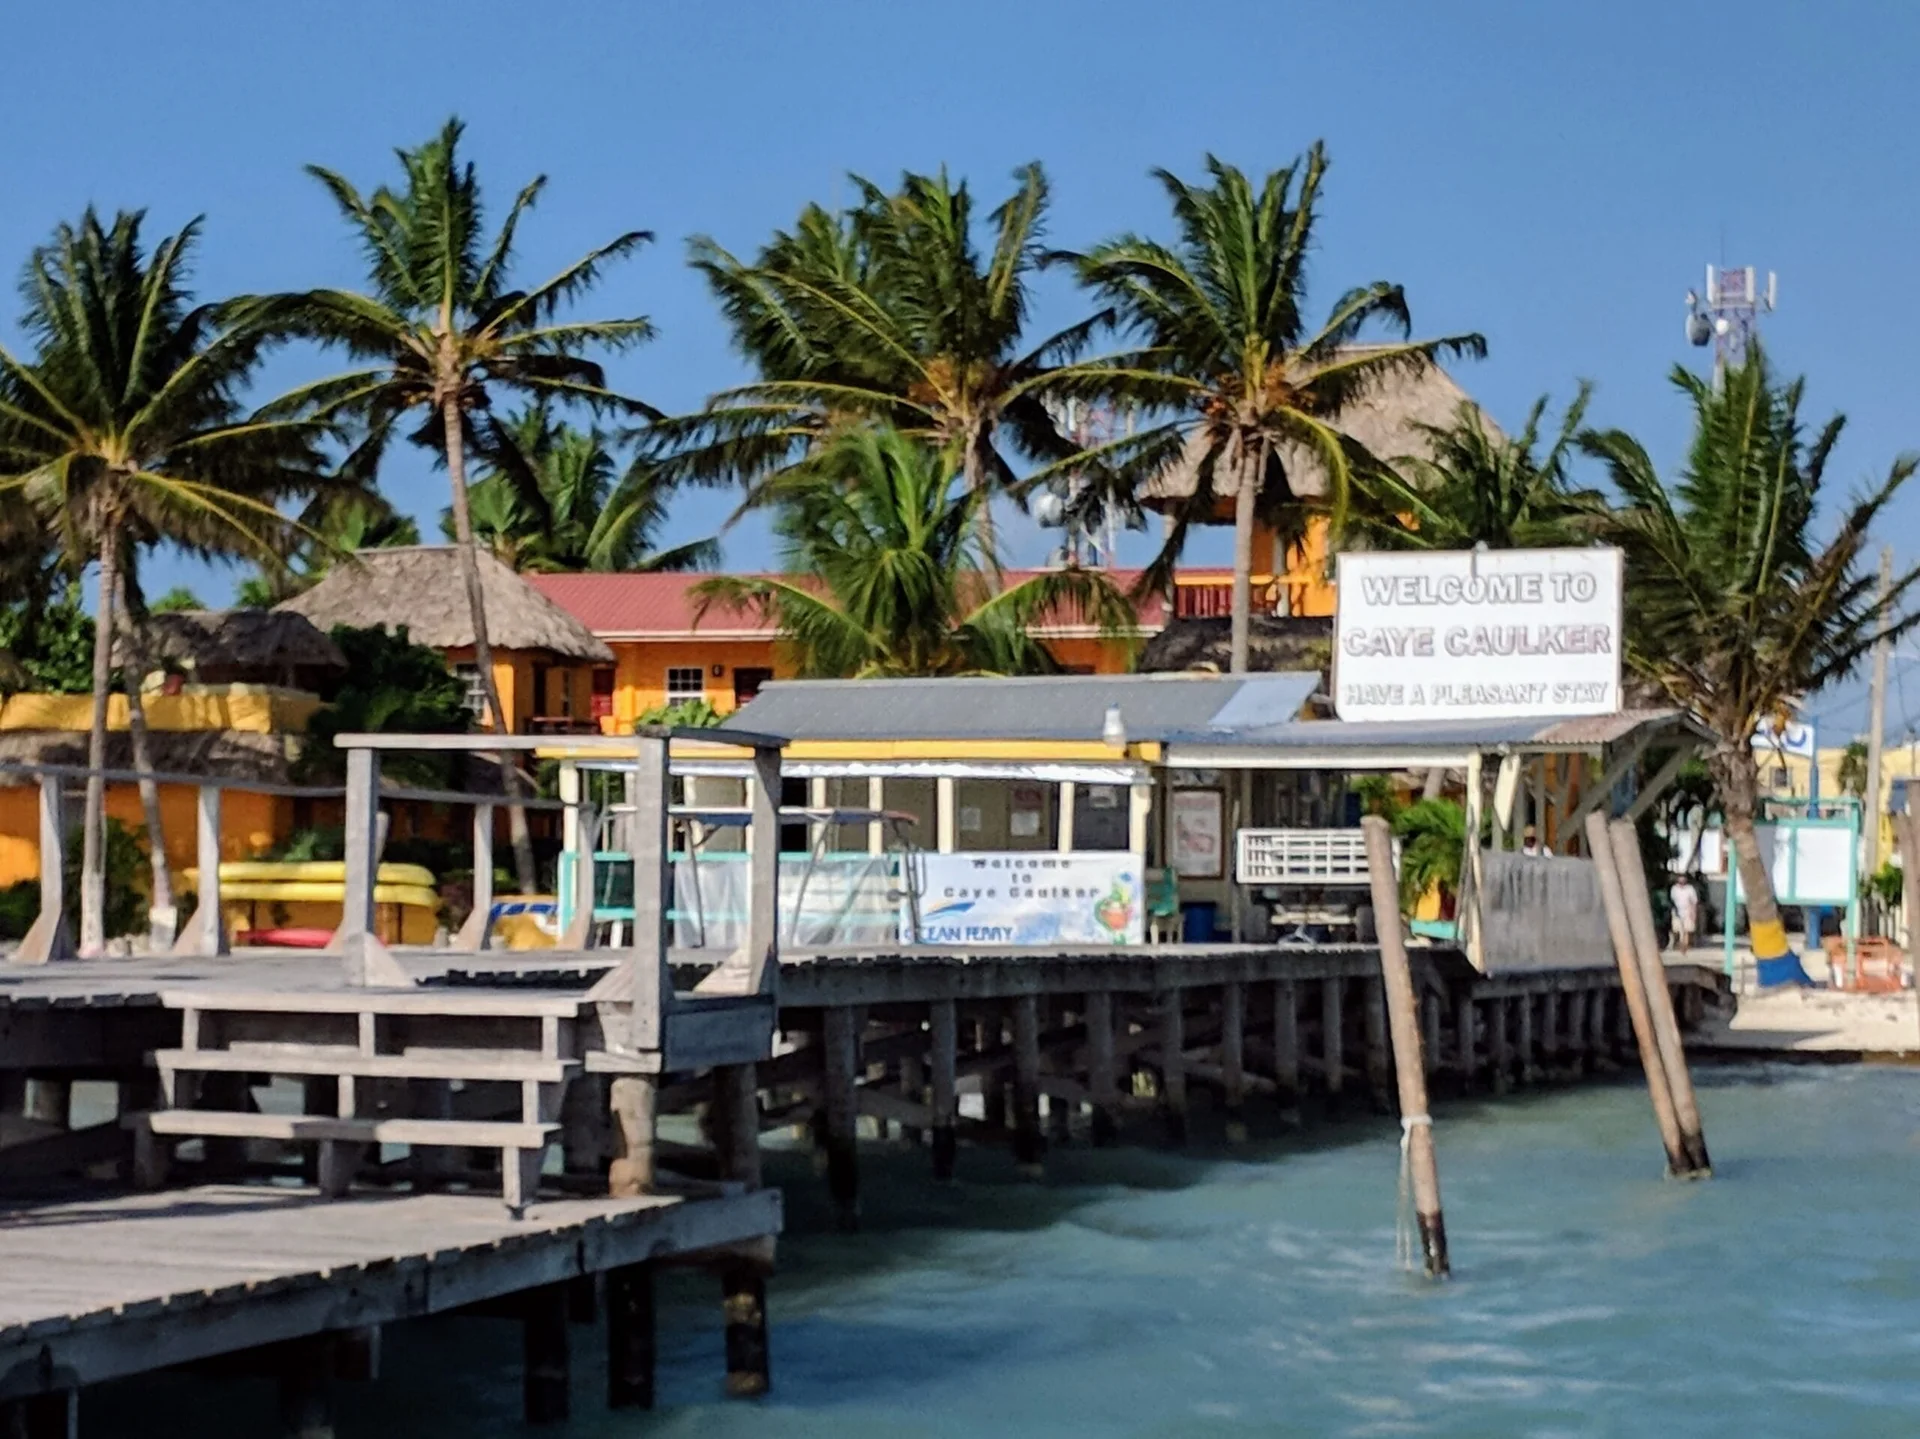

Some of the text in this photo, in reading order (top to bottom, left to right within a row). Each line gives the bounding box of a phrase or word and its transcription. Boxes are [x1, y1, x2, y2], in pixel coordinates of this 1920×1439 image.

[1361, 571, 1597, 606] WELCOME TO
[1344, 623, 1612, 657] CAYE CAULKER
[1344, 681, 1610, 706] HAVE A PLEASANT STAY
[972, 858, 1072, 870] Welcome
[1011, 873, 1033, 884] to
[943, 886, 1099, 899] Caye Caulker
